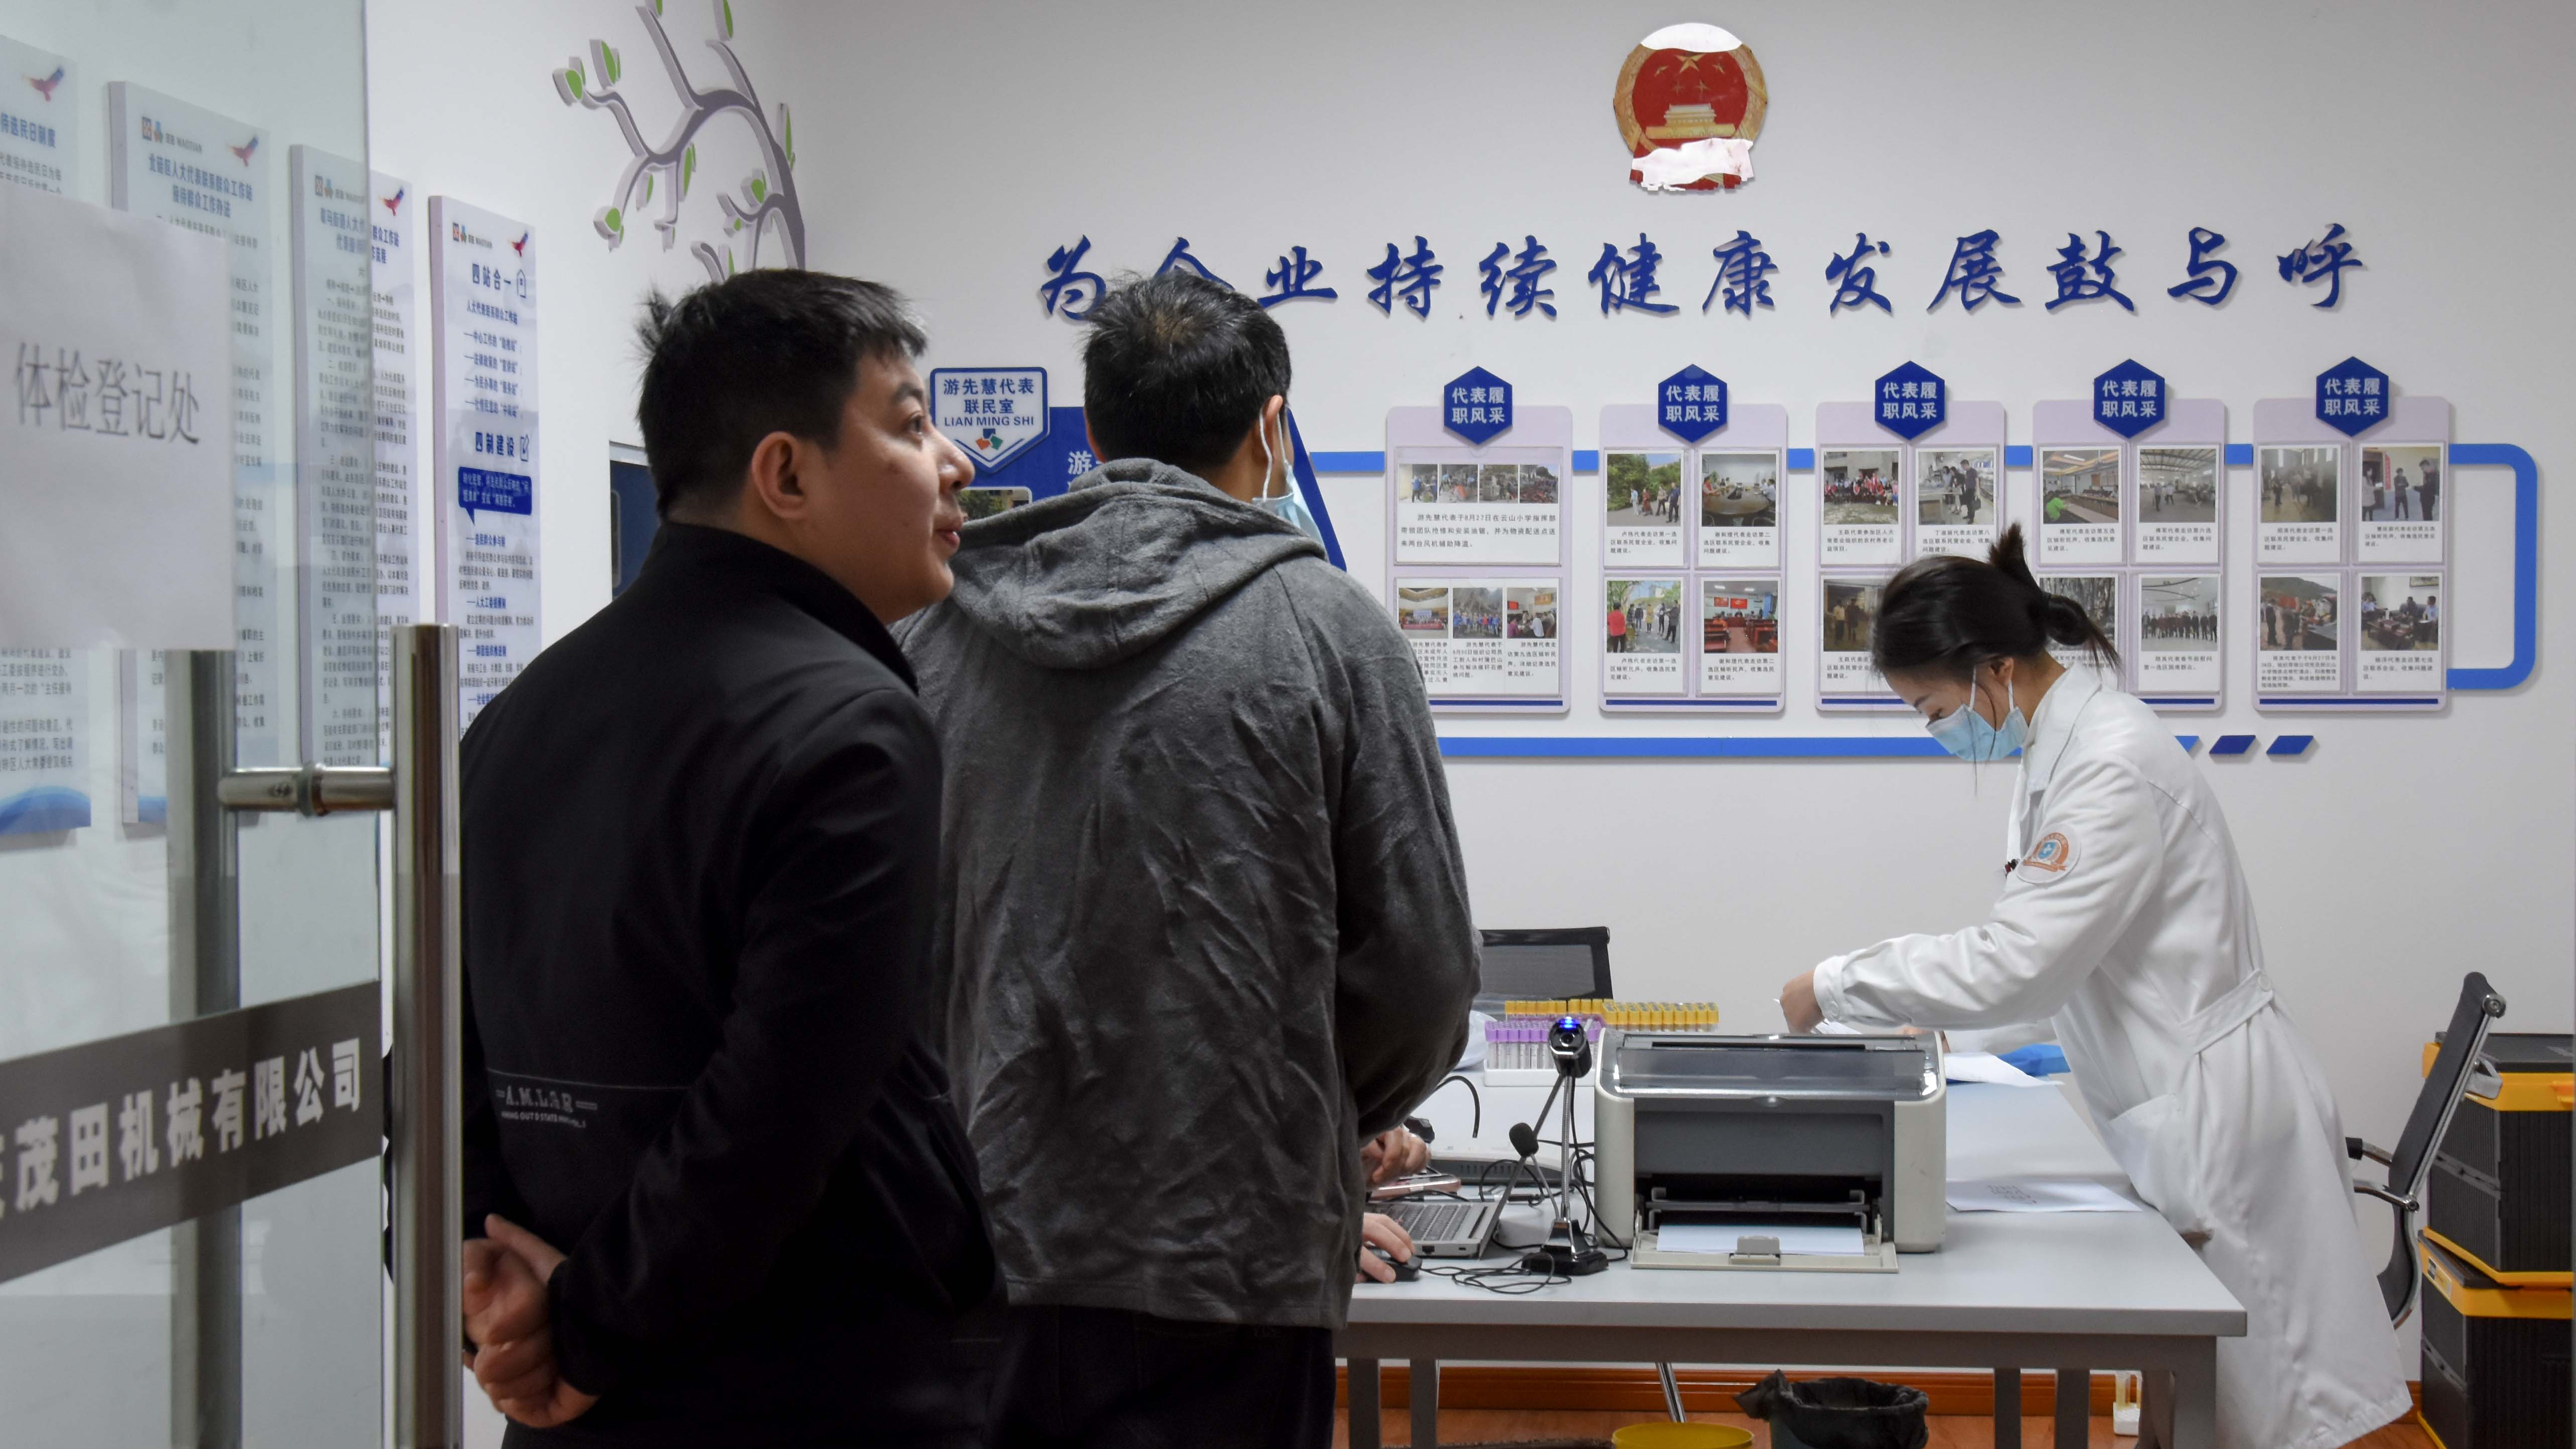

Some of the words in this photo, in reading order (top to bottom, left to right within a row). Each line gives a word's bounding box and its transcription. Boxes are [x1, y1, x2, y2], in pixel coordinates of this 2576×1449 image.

[472, 264, 511, 290] 四站合一
[13, 342, 199, 444] 体检登记处
[943, 378, 1034, 395] 游先慧代表
[1666, 385, 1719, 402] 代表履
[1883, 382, 1937, 399] 代表履
[2102, 380, 2157, 397] 代表履
[2325, 378, 2380, 395] 代表履
[1452, 387, 1505, 404] 代表履
[964, 399, 1014, 414] 联民室
[1666, 405, 1719, 422] 职风采
[1883, 403, 1937, 419] 职风采
[2102, 401, 2156, 418] 职风采
[2325, 399, 2380, 416] 职风采
[944, 417, 974, 427] LIAN
[976, 417, 1010, 427] MING
[1013, 417, 1034, 427] SHI
[1452, 408, 1505, 424] 职风采
[476, 432, 514, 458] 四制建设
[0, 1037, 360, 1219] 茂田机械有限公司
